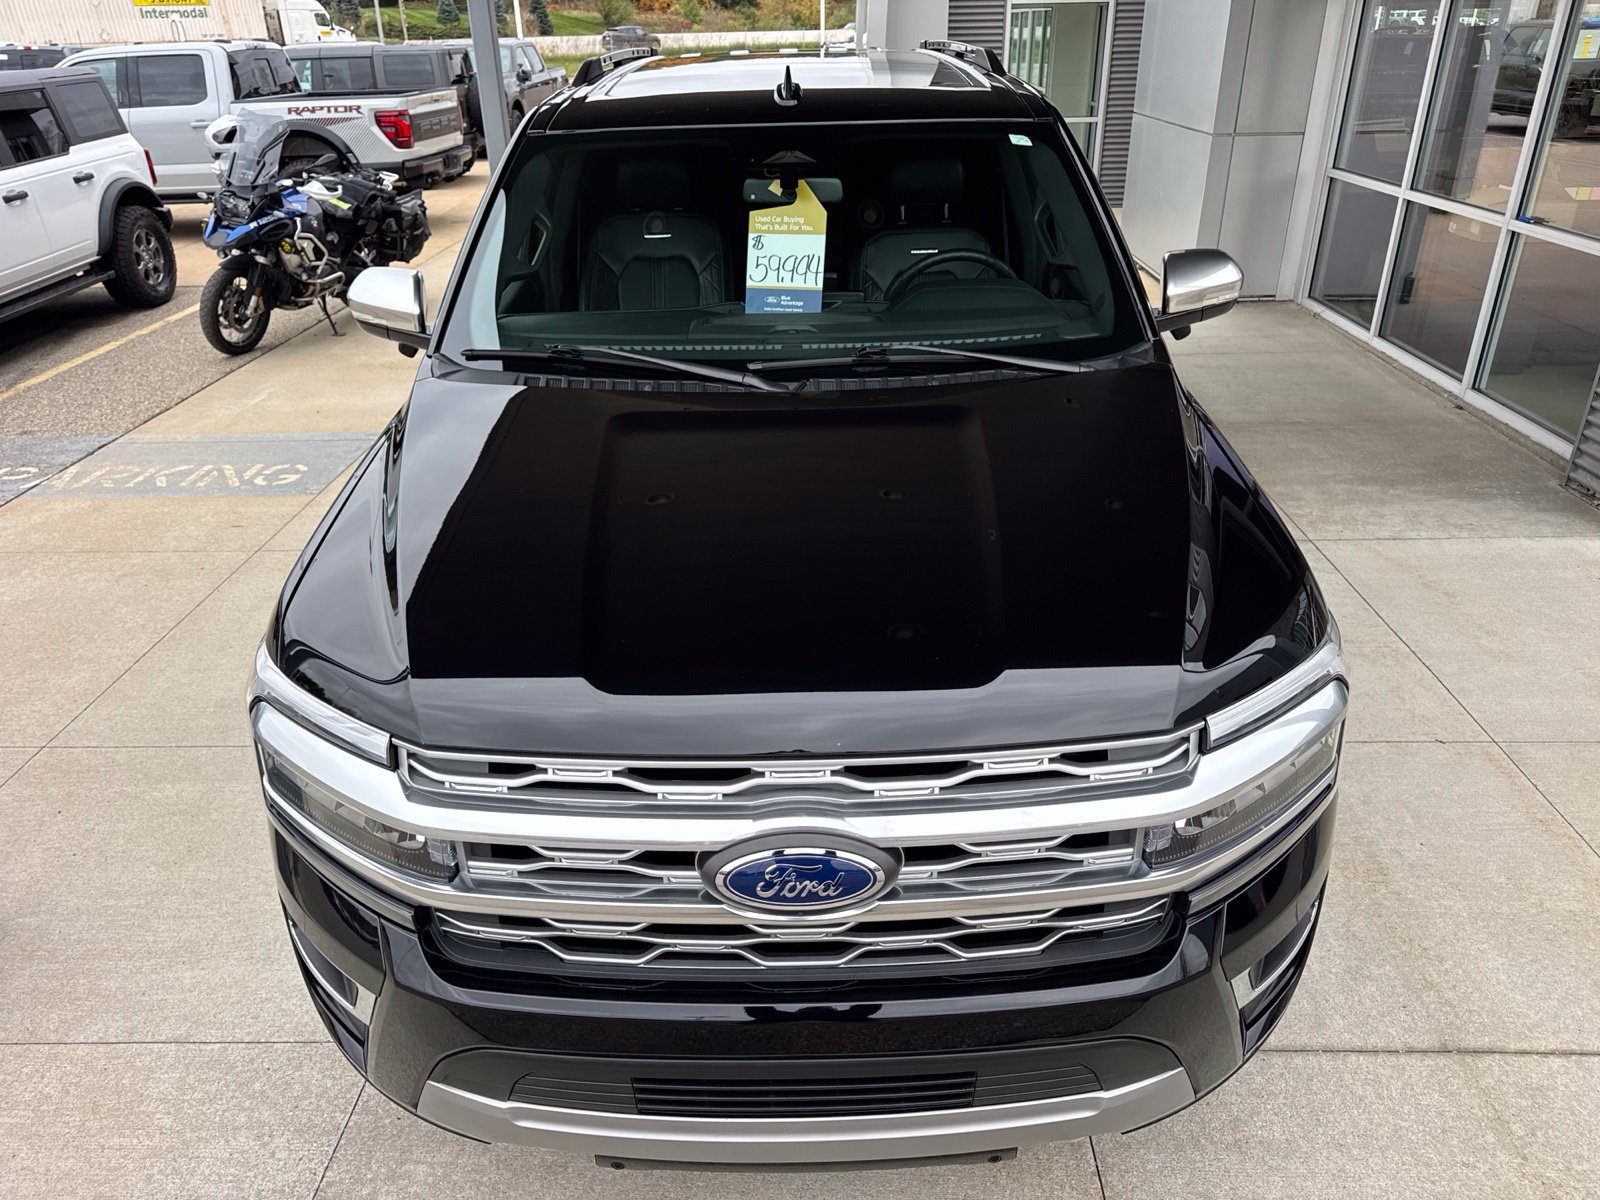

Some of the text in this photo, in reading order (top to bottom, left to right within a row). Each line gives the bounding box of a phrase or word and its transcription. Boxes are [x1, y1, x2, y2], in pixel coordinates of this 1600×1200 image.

[139, 8, 209, 19] Intermodal
[287, 105, 366, 117] RAPTOR
[783, 216, 805, 225] Buying
[755, 223, 774, 231] That's
[752, 234, 765, 250] $
[756, 864, 846, 899] Ford
